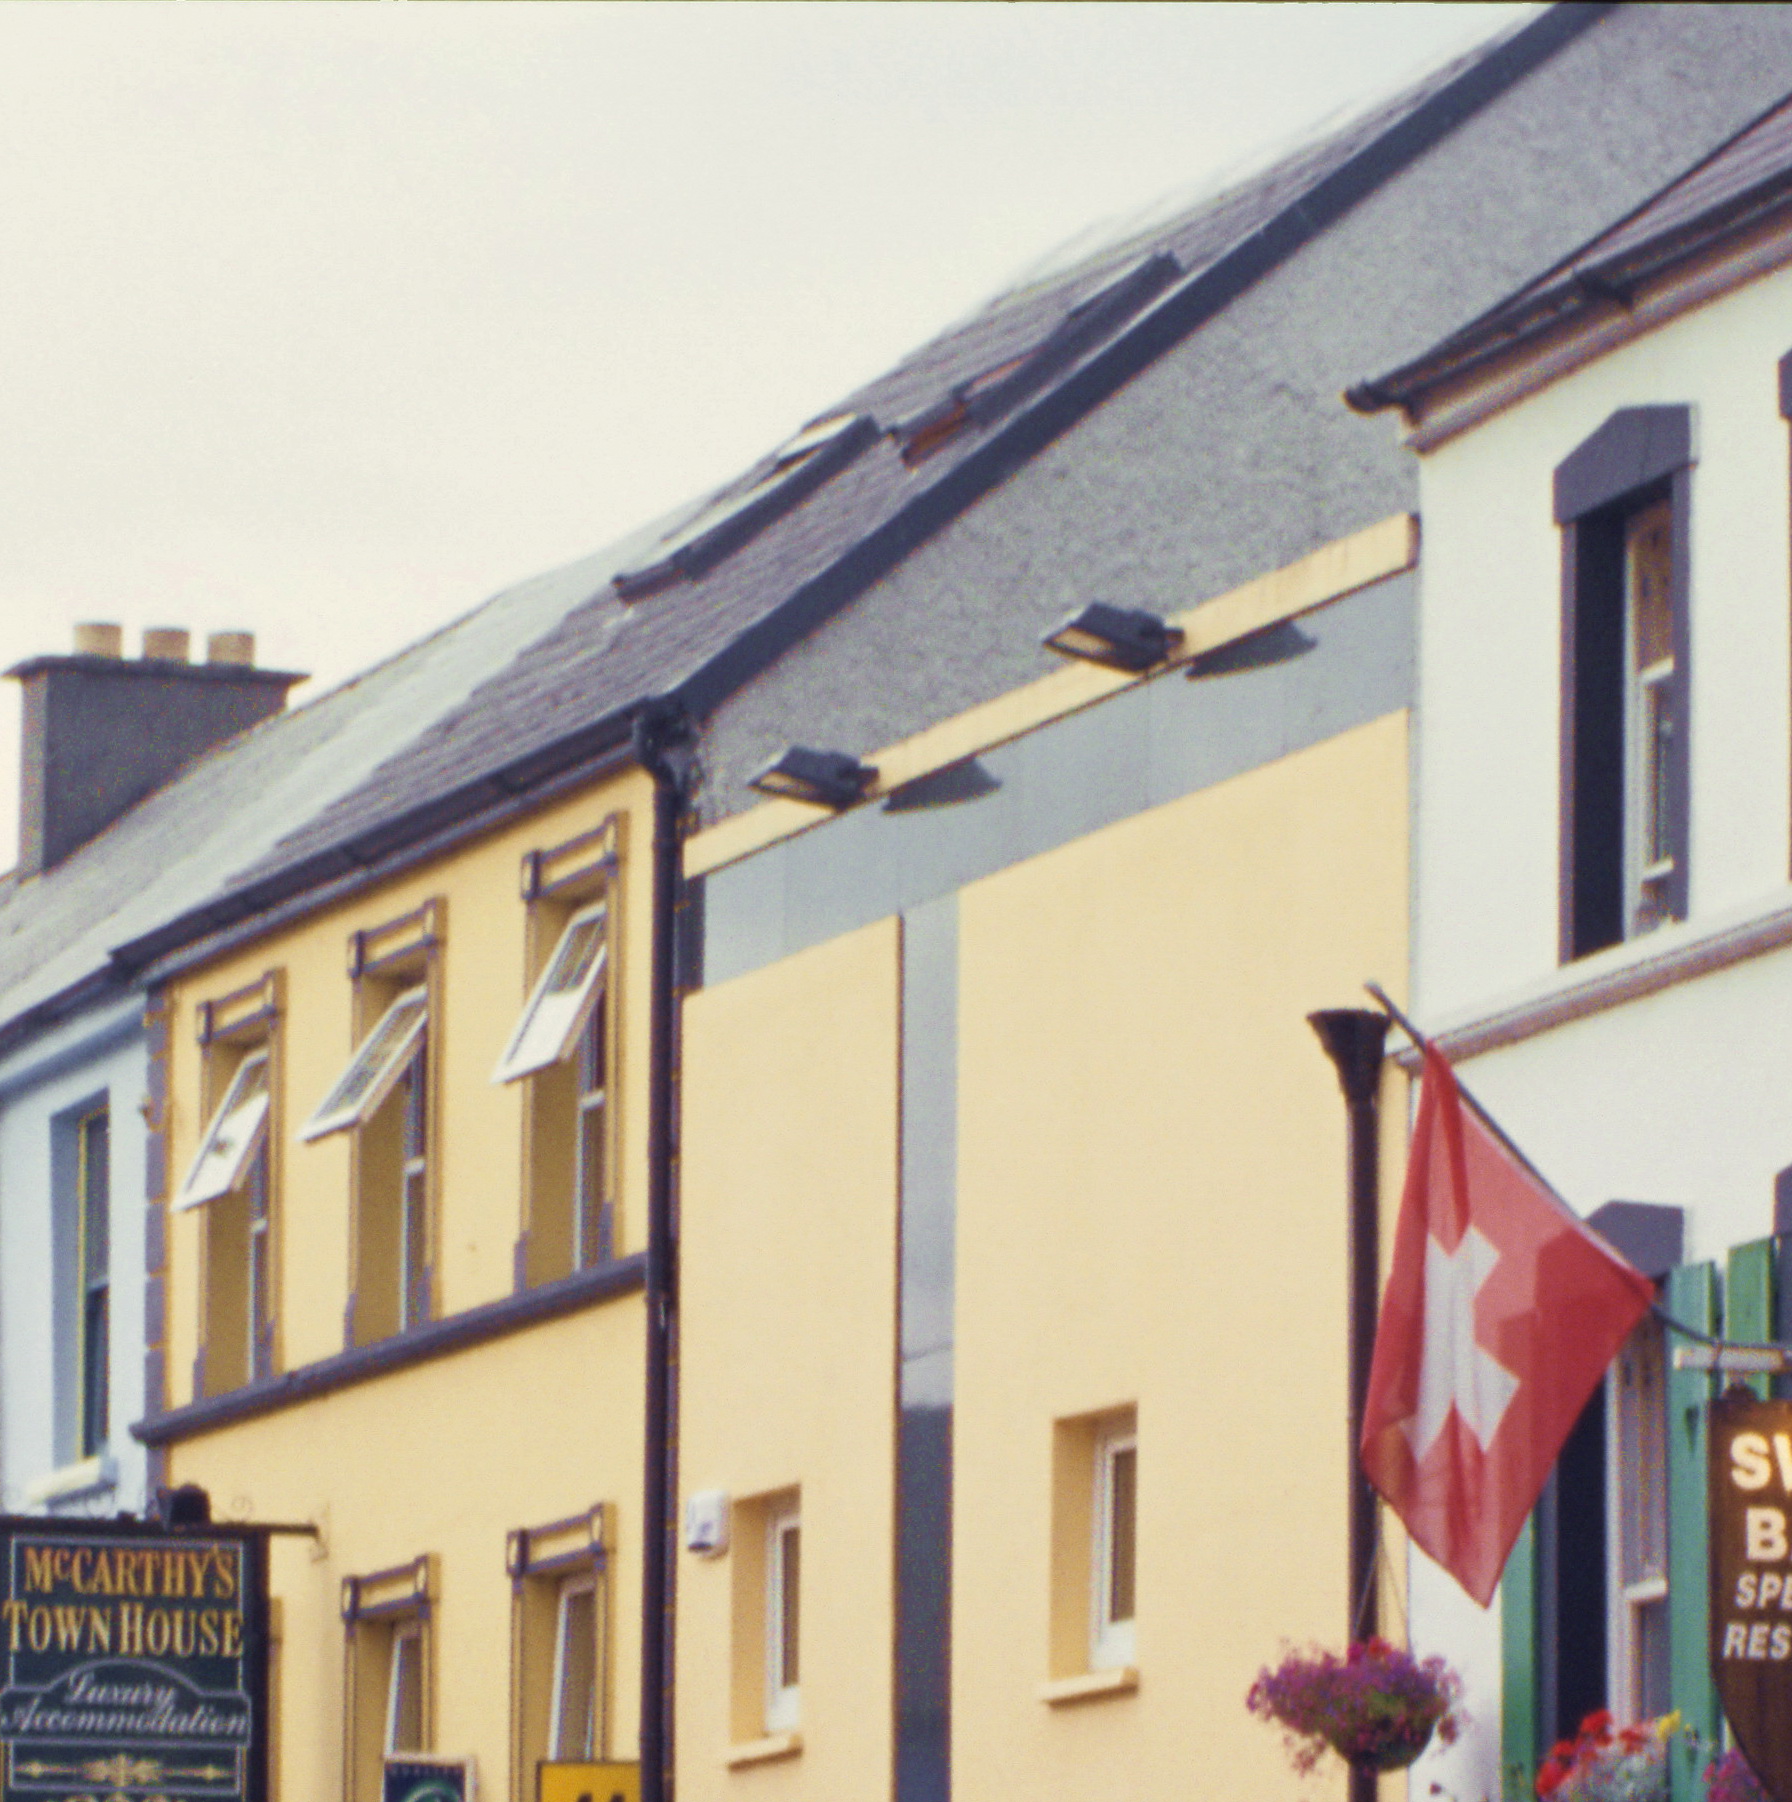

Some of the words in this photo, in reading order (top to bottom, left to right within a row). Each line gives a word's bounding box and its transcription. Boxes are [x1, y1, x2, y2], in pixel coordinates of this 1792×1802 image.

[2, 1599, 110, 1653] TOWN
[119, 1600, 244, 1657] HOUSE
[65, 1671, 176, 1711] Luxury
